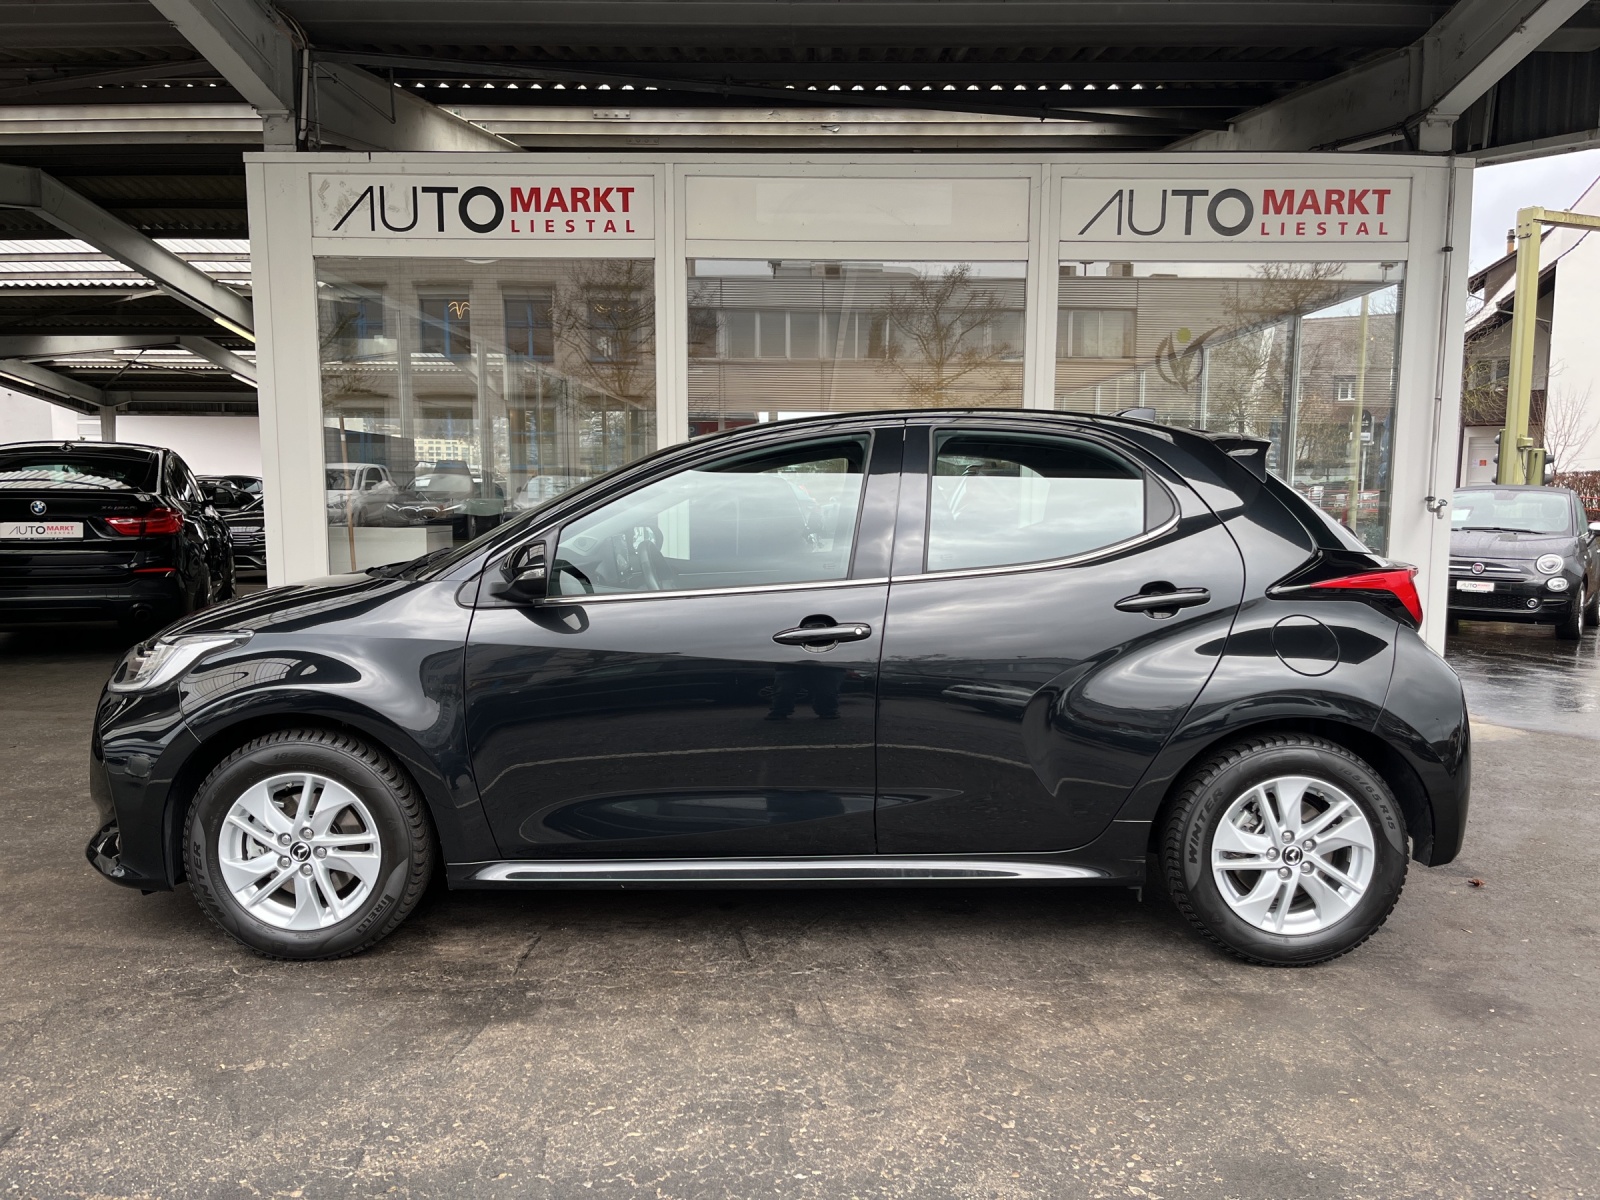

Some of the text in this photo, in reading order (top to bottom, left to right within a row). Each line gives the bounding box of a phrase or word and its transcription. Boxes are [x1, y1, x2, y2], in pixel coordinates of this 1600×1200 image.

[331, 185, 635, 234] AUTO MARKT
[510, 219, 635, 233] LIESTAL
[1077, 188, 1391, 237] AUTO MARKT
[1260, 221, 1389, 236] LIESTAL
[9, 525, 46, 535] AUTO
[1189, 786, 1225, 865] WINTER
[193, 840, 226, 921] WINTER
[354, 893, 396, 938] PIRELLI
